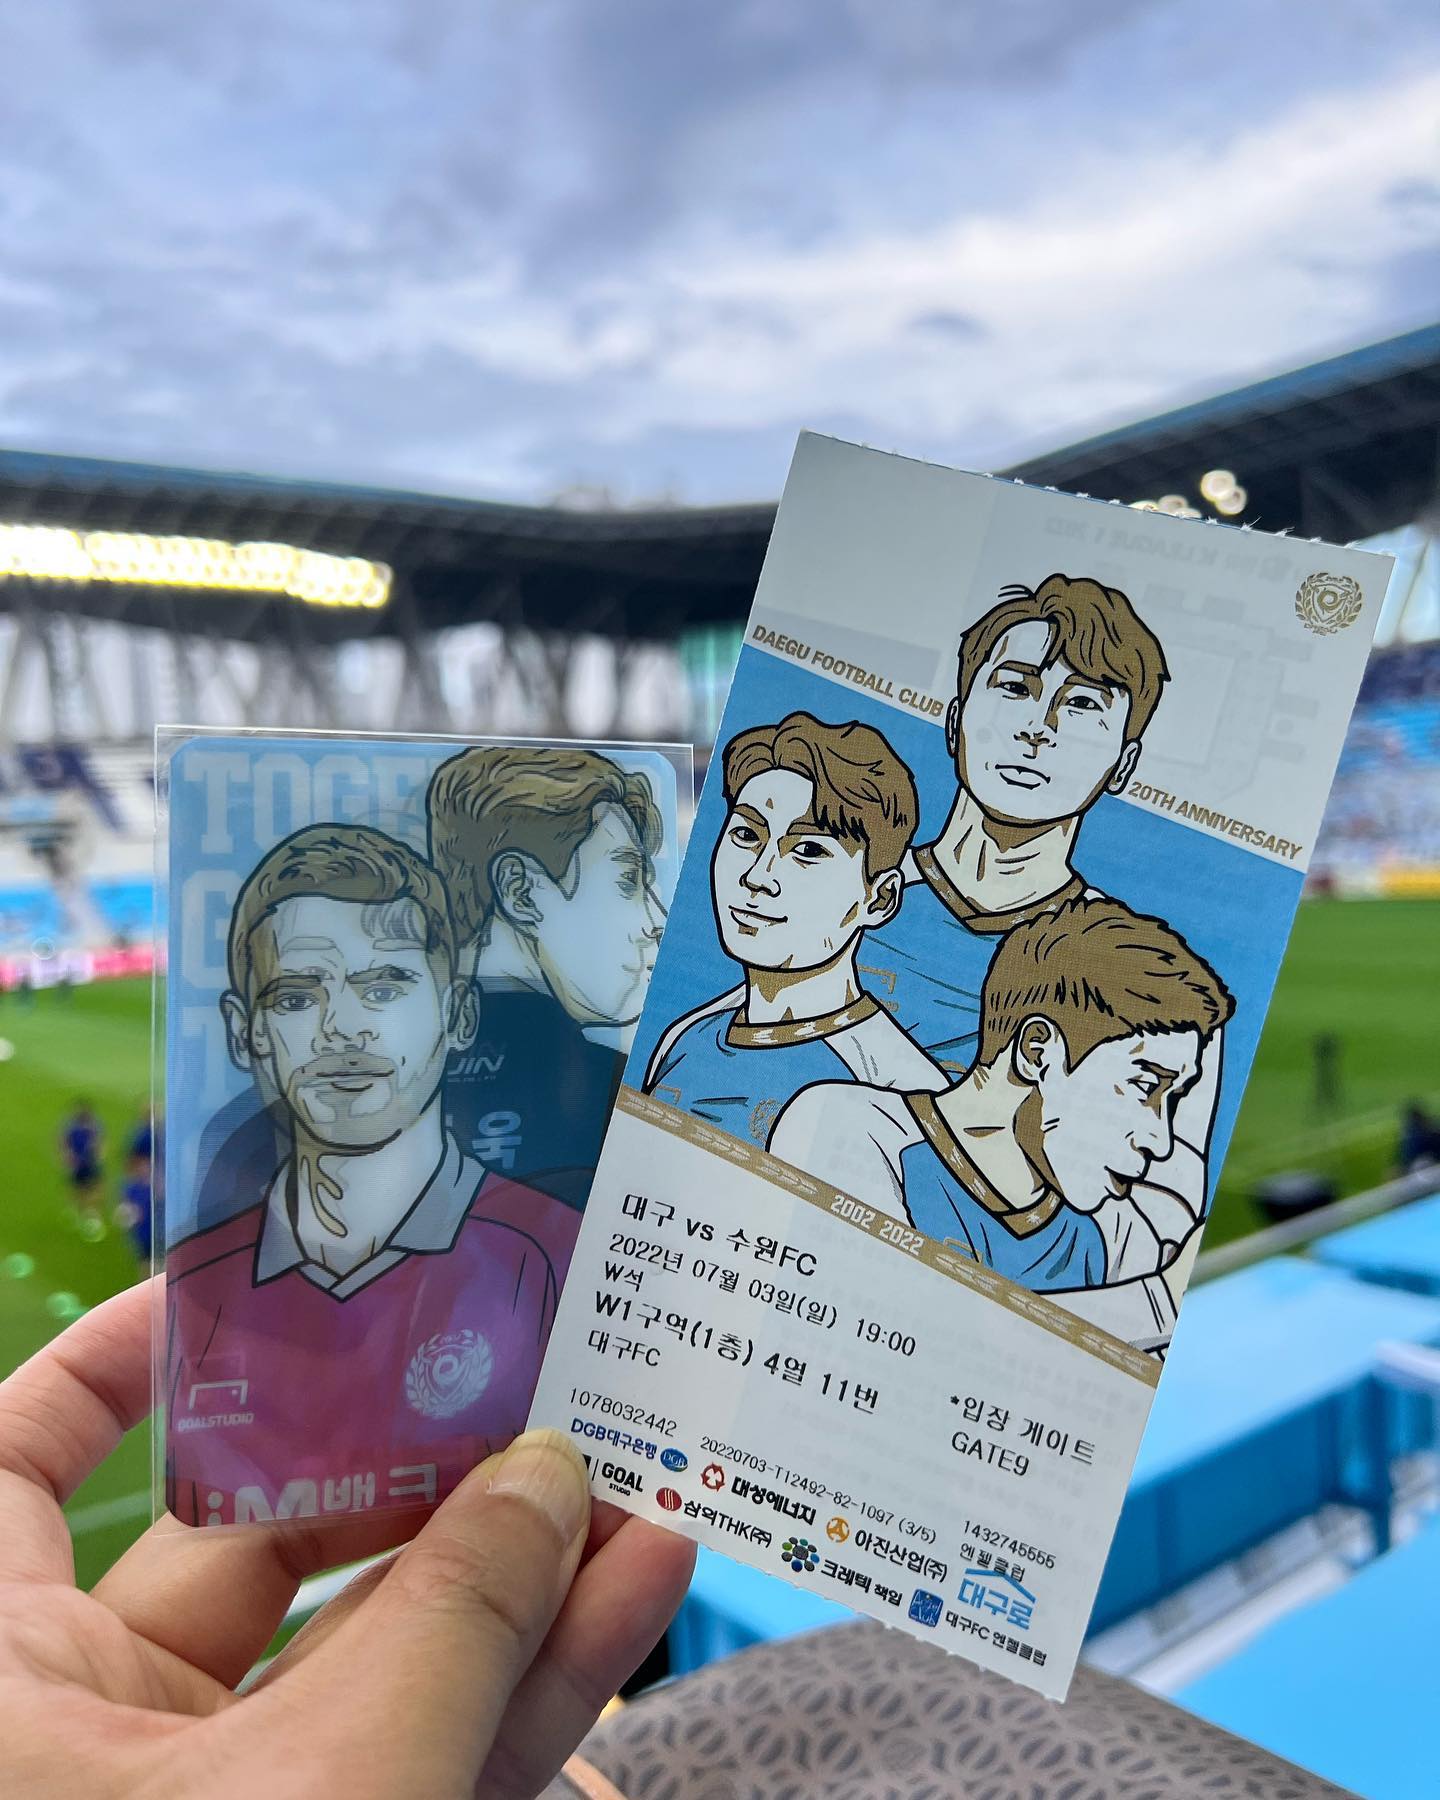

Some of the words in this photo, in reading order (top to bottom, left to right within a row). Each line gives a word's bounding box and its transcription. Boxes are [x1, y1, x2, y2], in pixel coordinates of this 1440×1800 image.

[752, 624, 811, 660] DAEGU
[811, 649, 894, 698] FOOTBALL
[898, 687, 945, 718] CLUB
[1128, 781, 1176, 811] 20TH
[1174, 800, 1303, 860] ANNIVERSARY
[621, 1194, 676, 1227] 대구
[686, 1218, 715, 1241] vs
[726, 1228, 818, 1277] 수원FC
[830, 1194, 876, 1229] 2002
[879, 1220, 925, 1256] 2022
[605, 1261, 644, 1292] W석
[609, 1233, 684, 1274] 2022년
[692, 1259, 740, 1293] 07월
[748, 1279, 838, 1329] 03일(일)
[856, 1318, 916, 1357] 19:00
[587, 1329, 661, 1367] 대구FC
[595, 1290, 754, 1367] W1구역(1층)
[763, 1352, 807, 1386] 4열
[821, 1373, 879, 1415] 11번
[570, 1388, 678, 1437] 1078032442
[571, 1418, 658, 1461] DGB대구은행
[951, 1431, 1030, 1477] GATE9
[1019, 1417, 1096, 1466] 게이트
[601, 1462, 644, 1493] GOAL
[609, 1483, 631, 1497] STUDIO
[700, 1436, 895, 1527] 20220703-T12492-82-1097
[898, 1516, 937, 1546] (3/5)
[731, 1475, 817, 1526] 대성에너지
[855, 1529, 948, 1584] 아진산업(주)
[963, 1520, 1057, 1570] 1432745555
[945, 1610, 990, 1640] 대구FC
[957, 1578, 1034, 1631] 대구로
